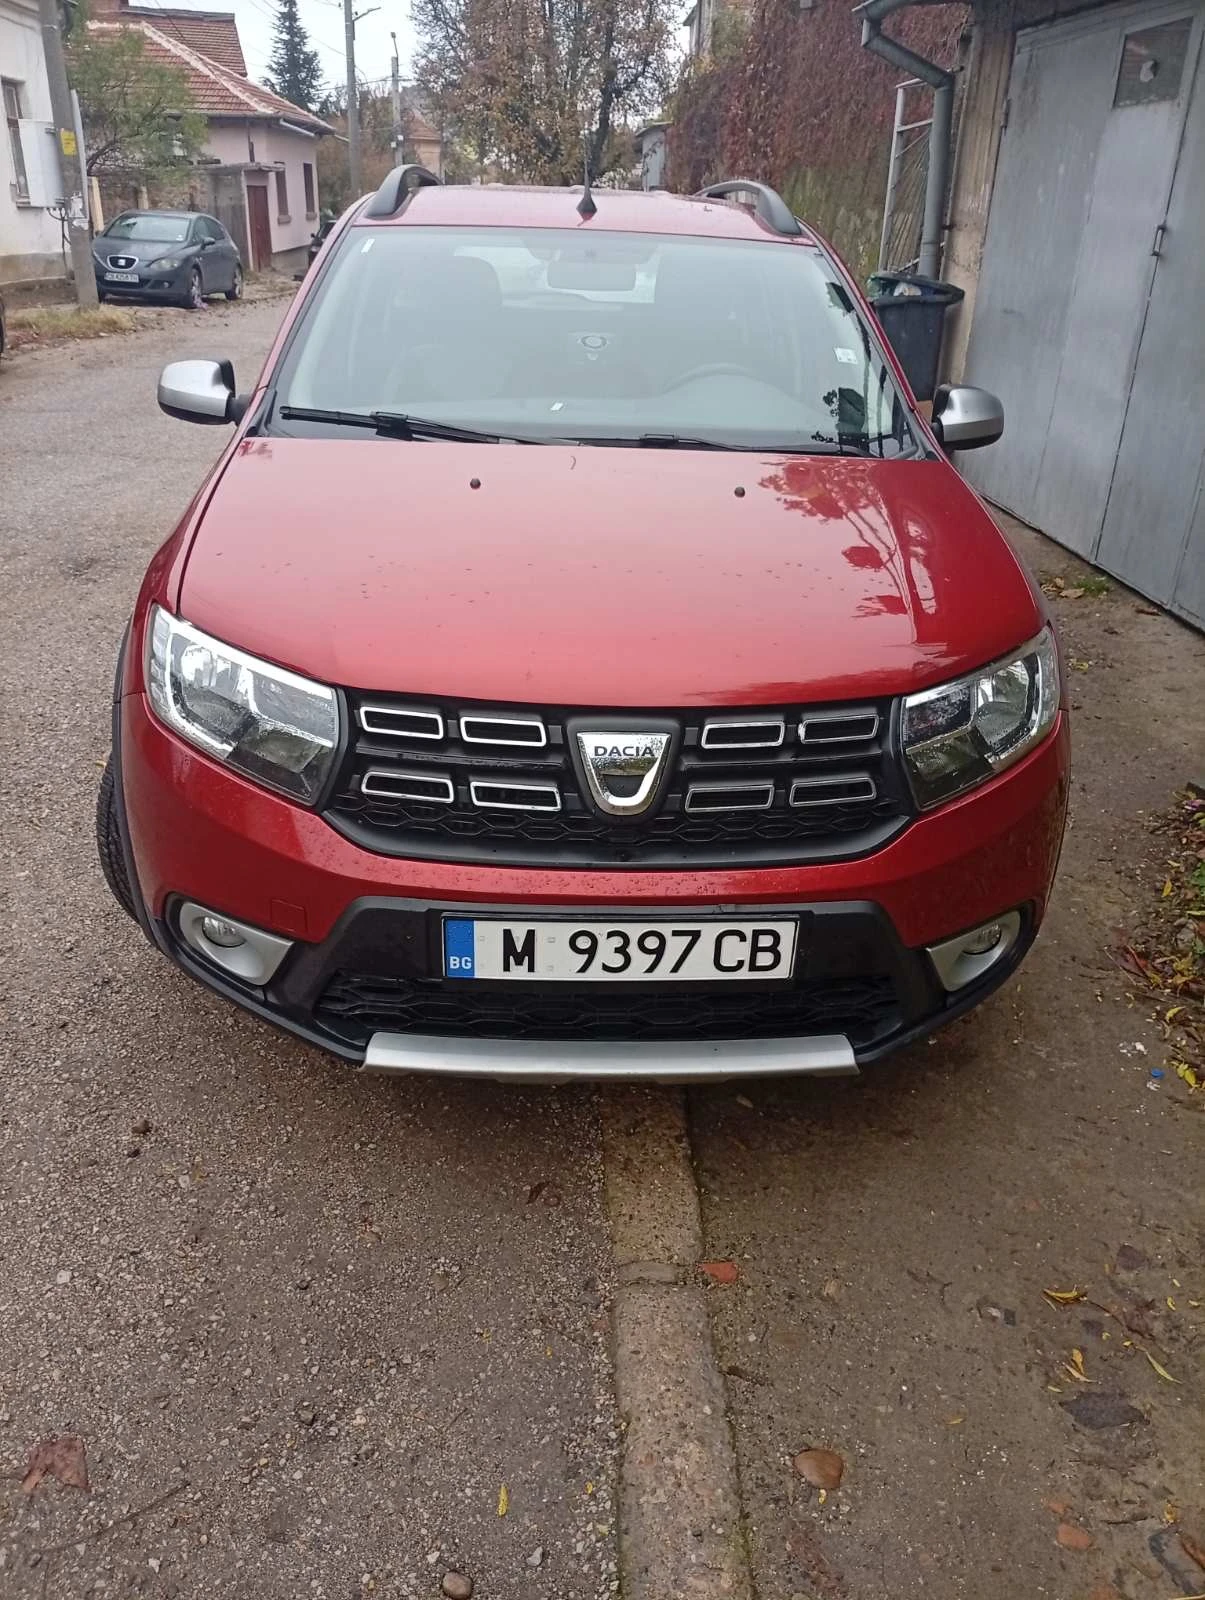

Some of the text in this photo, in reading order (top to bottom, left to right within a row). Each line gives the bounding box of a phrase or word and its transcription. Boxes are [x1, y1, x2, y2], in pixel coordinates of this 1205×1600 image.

[594, 746, 655, 757] DACIA
[502, 928, 782, 974] M 9397 CB
[449, 956, 472, 969] BG
